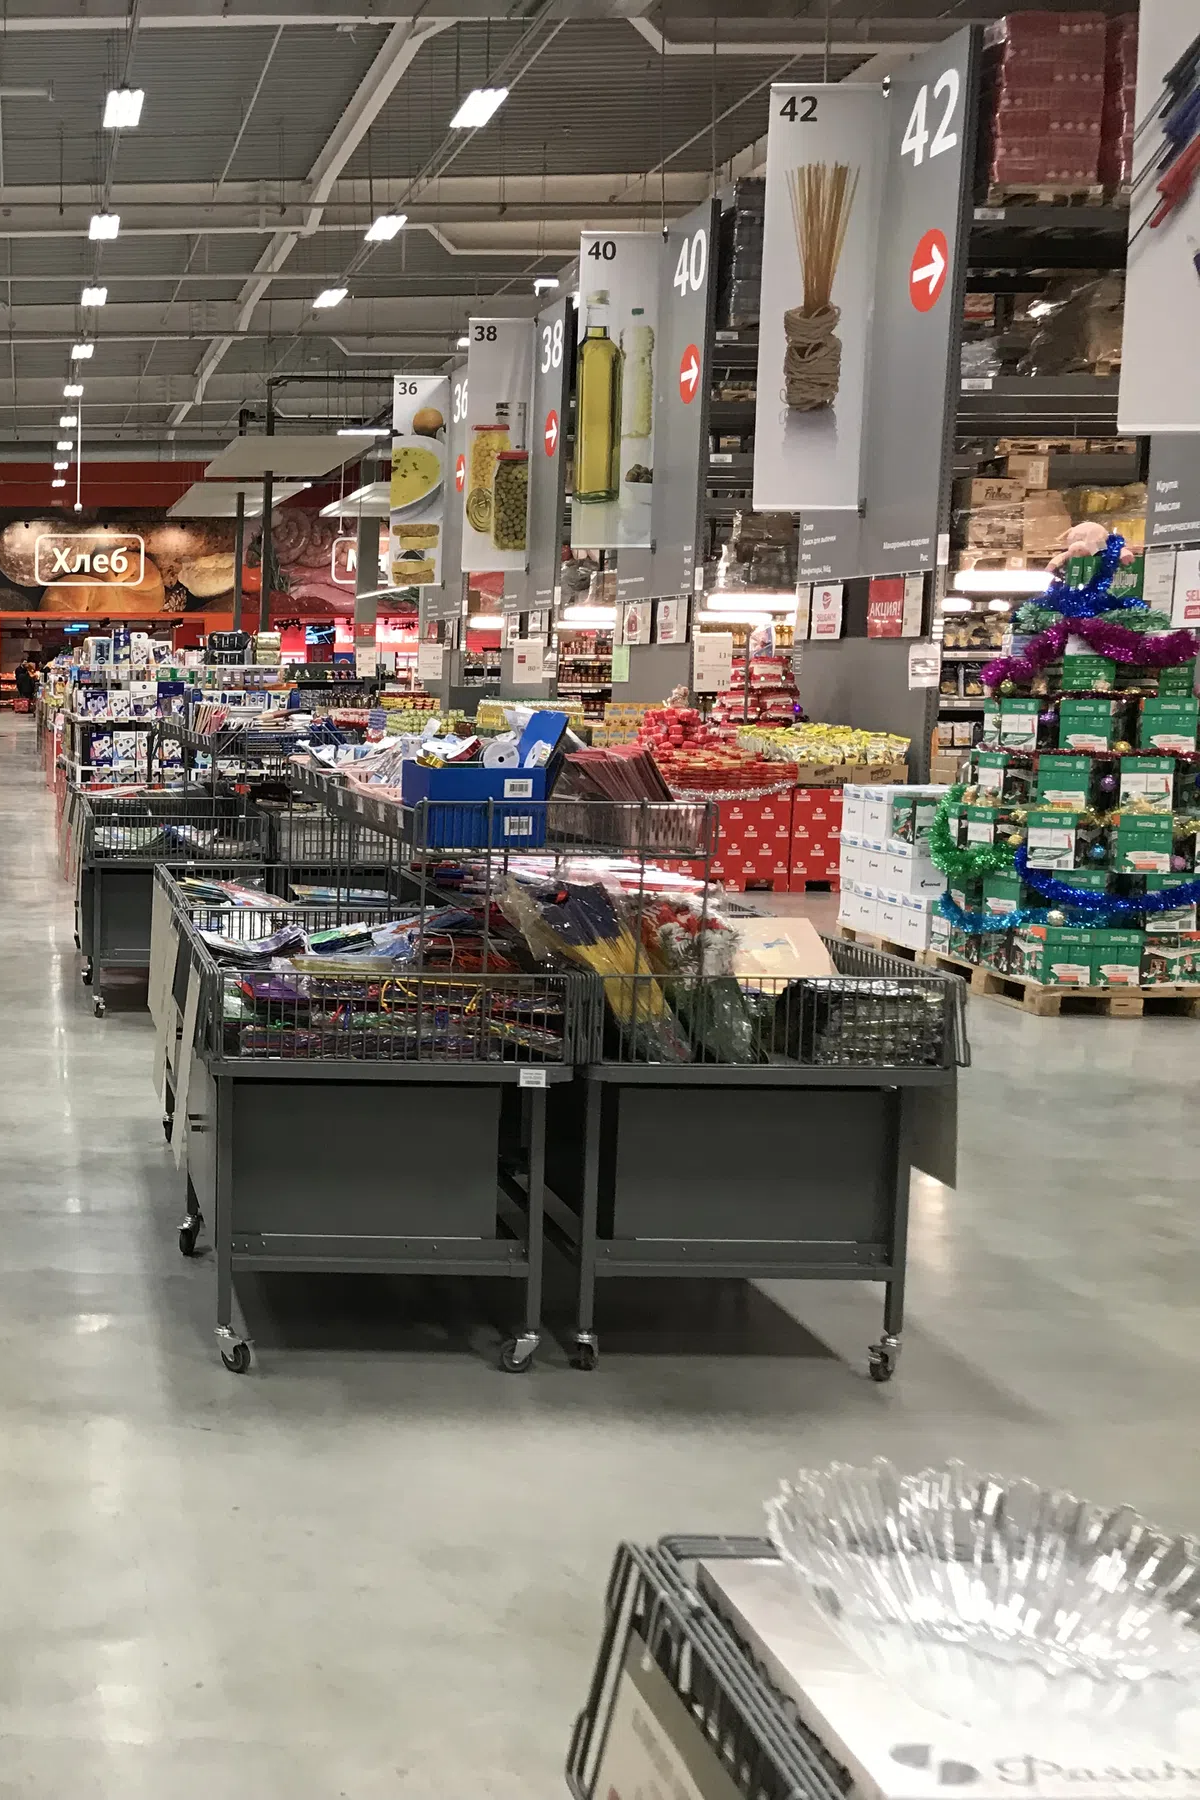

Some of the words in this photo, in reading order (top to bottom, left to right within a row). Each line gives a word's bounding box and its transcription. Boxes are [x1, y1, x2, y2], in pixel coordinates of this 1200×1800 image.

[779, 96, 818, 122] 42
[900, 68, 960, 167] 42
[587, 240, 617, 261] 40
[673, 228, 707, 297] 40
[474, 325, 498, 342] 38
[541, 318, 563, 374] 38
[398, 381, 418, 395] 36
[453, 378, 469, 424] 36
[1154, 501, 1181, 513] Мюсли
[51, 546, 128, 573] Хлеб
[870, 601, 901, 620] АКЦИЯ!
